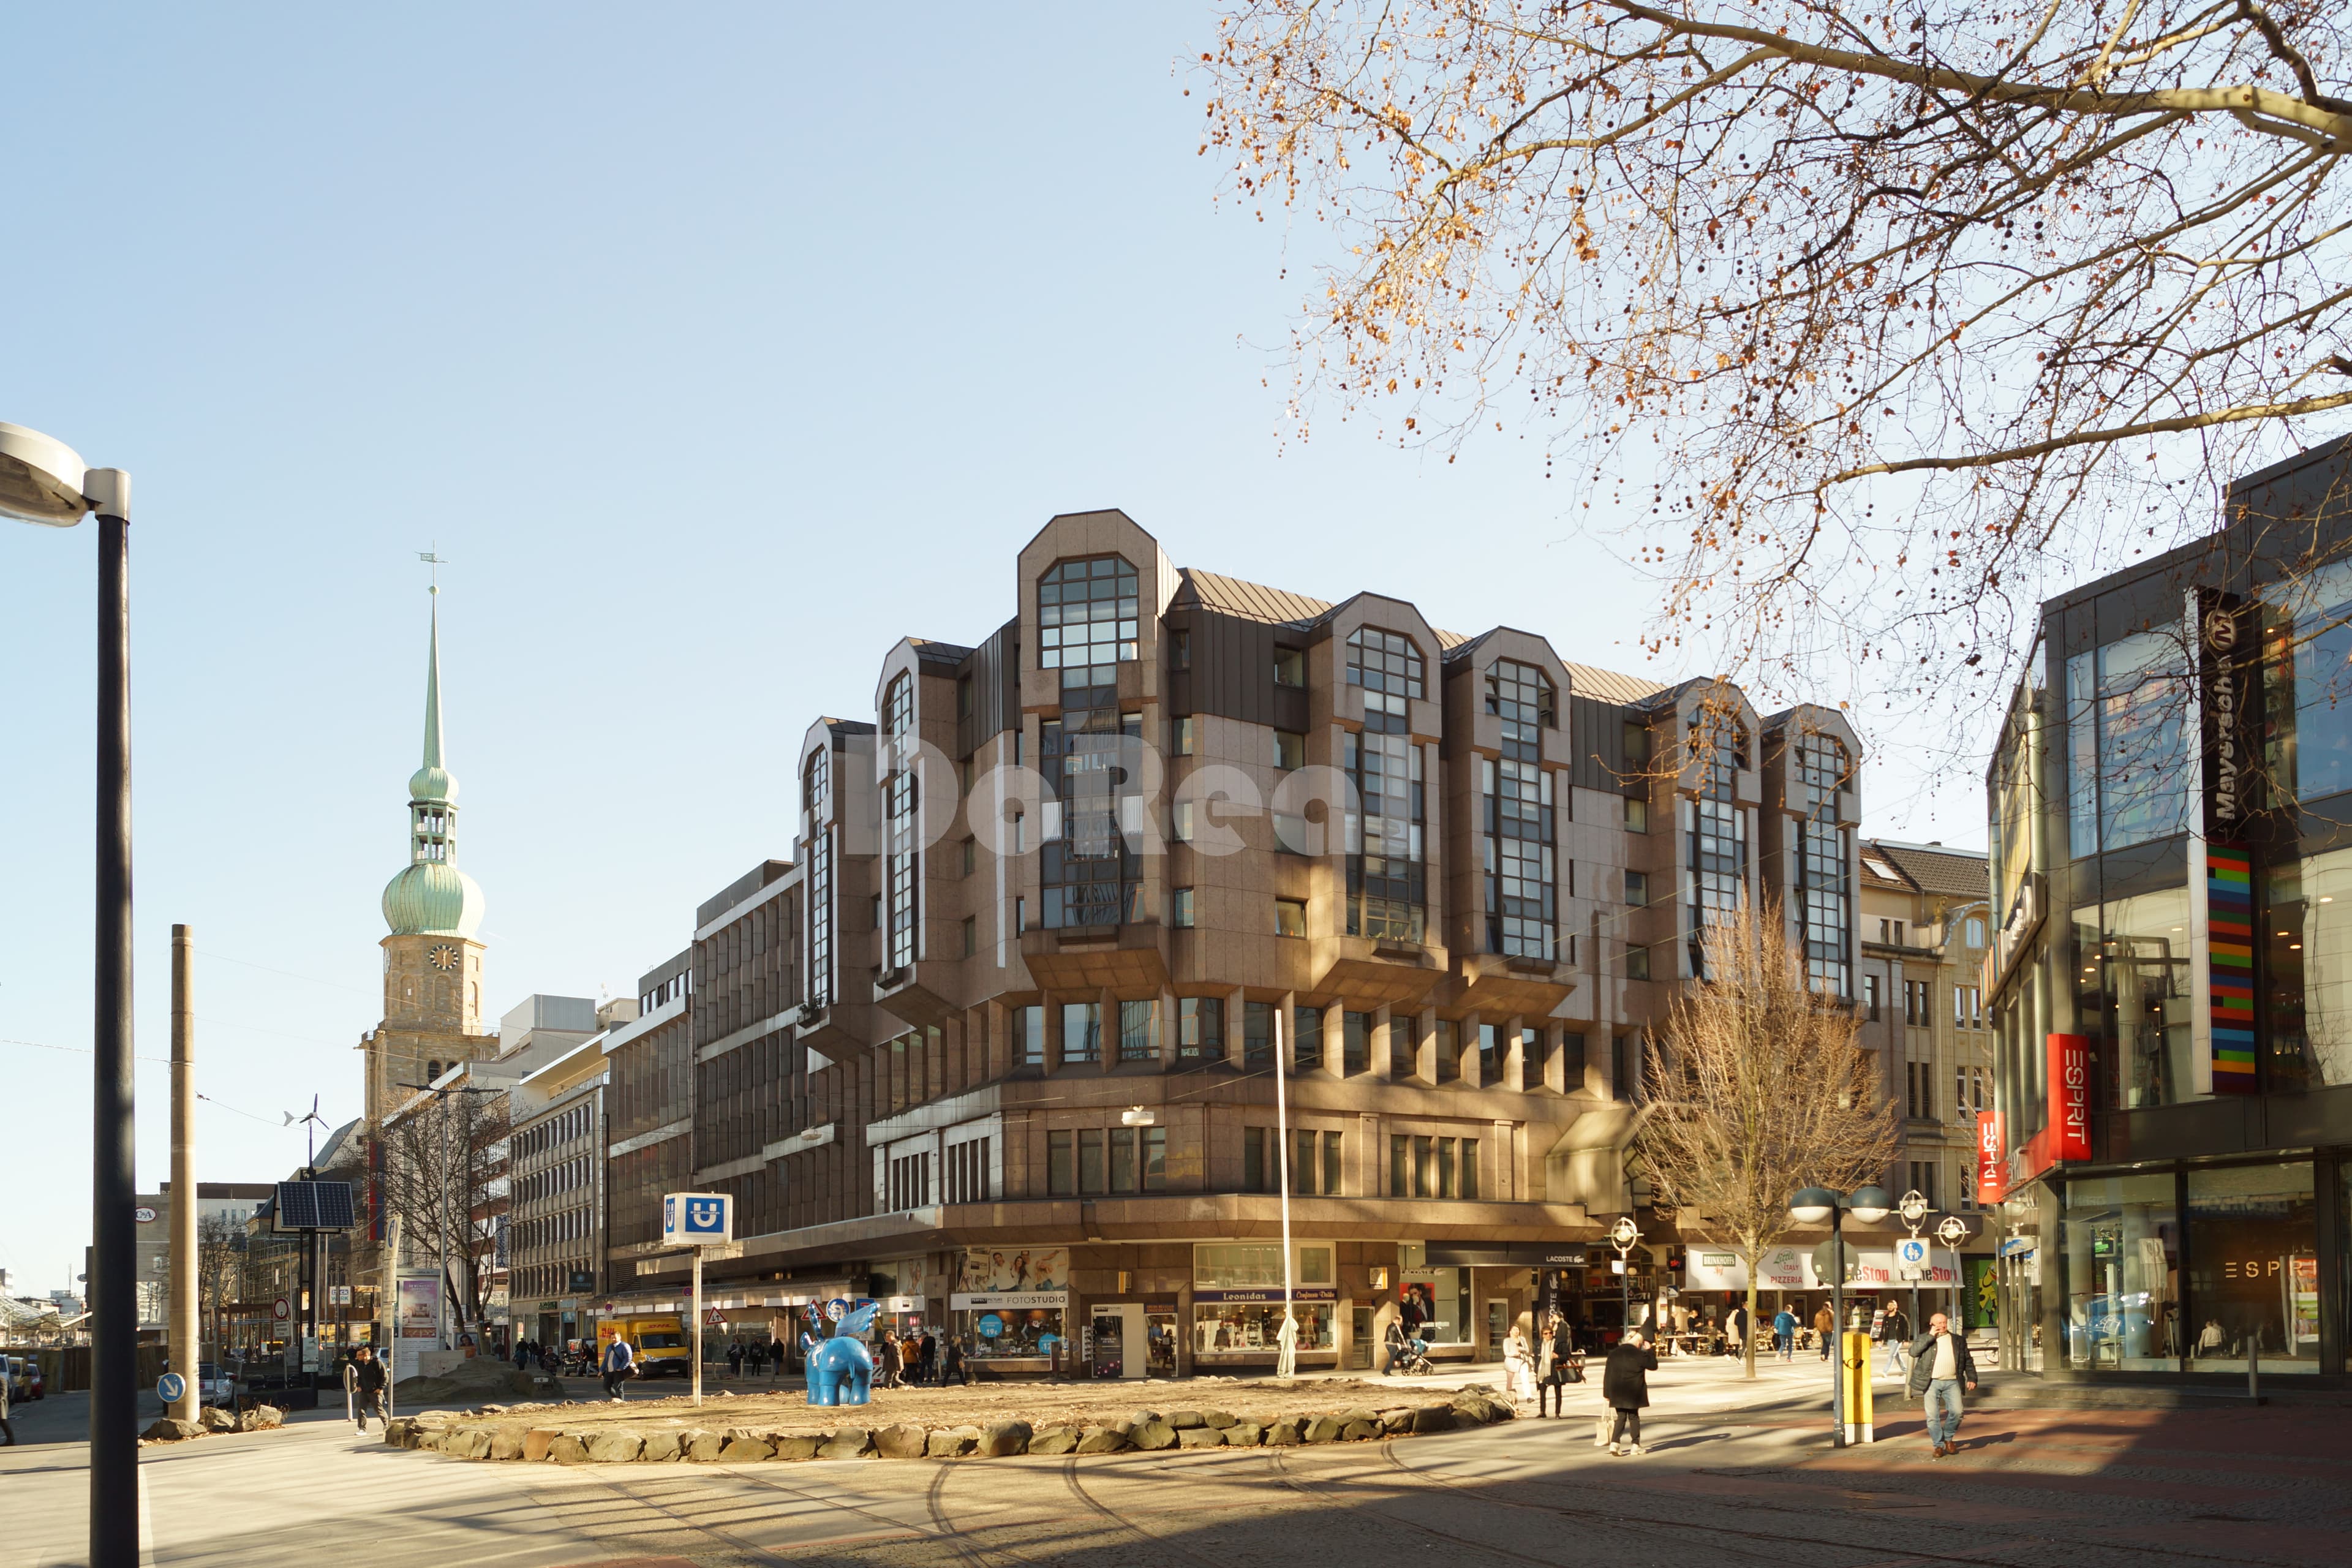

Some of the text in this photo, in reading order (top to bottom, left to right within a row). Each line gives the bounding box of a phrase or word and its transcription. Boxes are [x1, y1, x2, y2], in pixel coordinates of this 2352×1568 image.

[2208, 654, 2238, 820] Mayersche
[2065, 1049, 2086, 1145] ESPRIT
[694, 1203, 717, 1227] U
[1852, 1265, 1890, 1283] eStop
[1900, 1266, 1958, 1281] eStop
[1223, 1292, 1266, 1300] Leonidas
[1966, 1269, 1975, 1325] SALAMANDER
